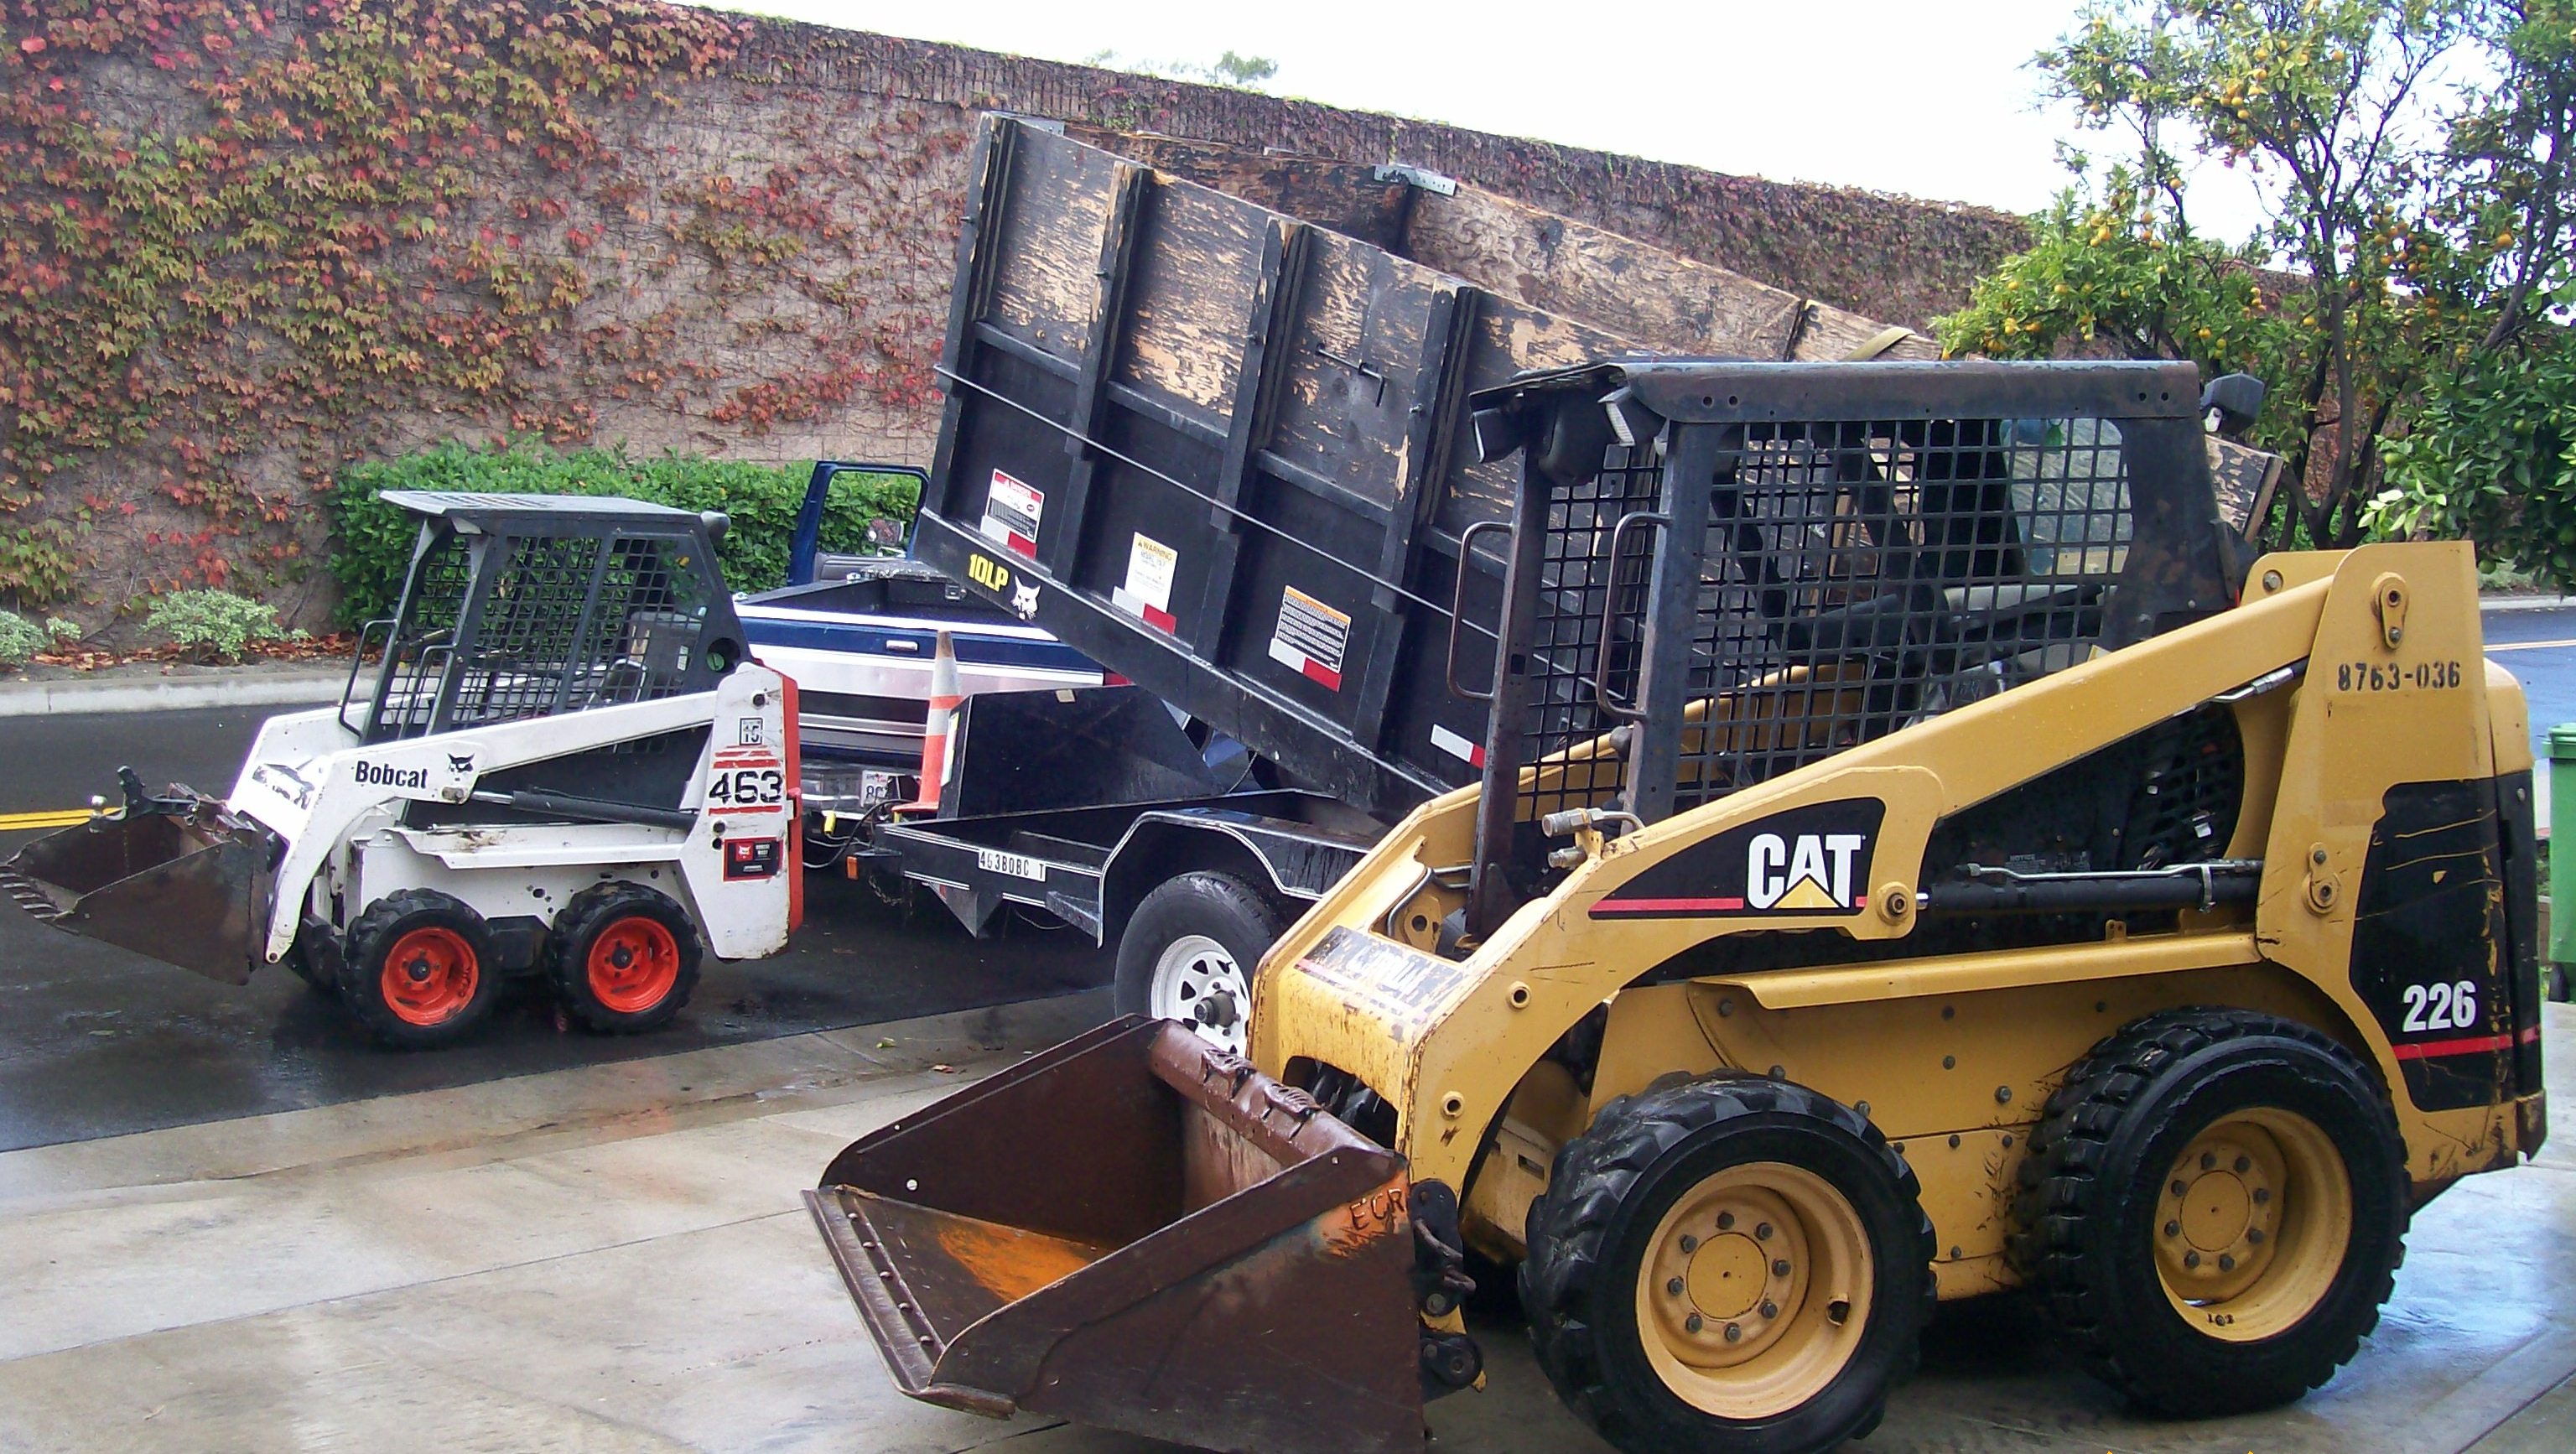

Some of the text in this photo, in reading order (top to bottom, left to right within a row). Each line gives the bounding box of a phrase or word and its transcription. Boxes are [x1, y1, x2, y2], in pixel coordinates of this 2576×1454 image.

[969, 553, 1009, 592] 10LP
[2338, 661, 2460, 691] 8763-036
[356, 761, 428, 789] Bobcat
[709, 770, 783, 804] 463
[1748, 833, 1861, 909] CAT
[2402, 980, 2476, 1032] 226
